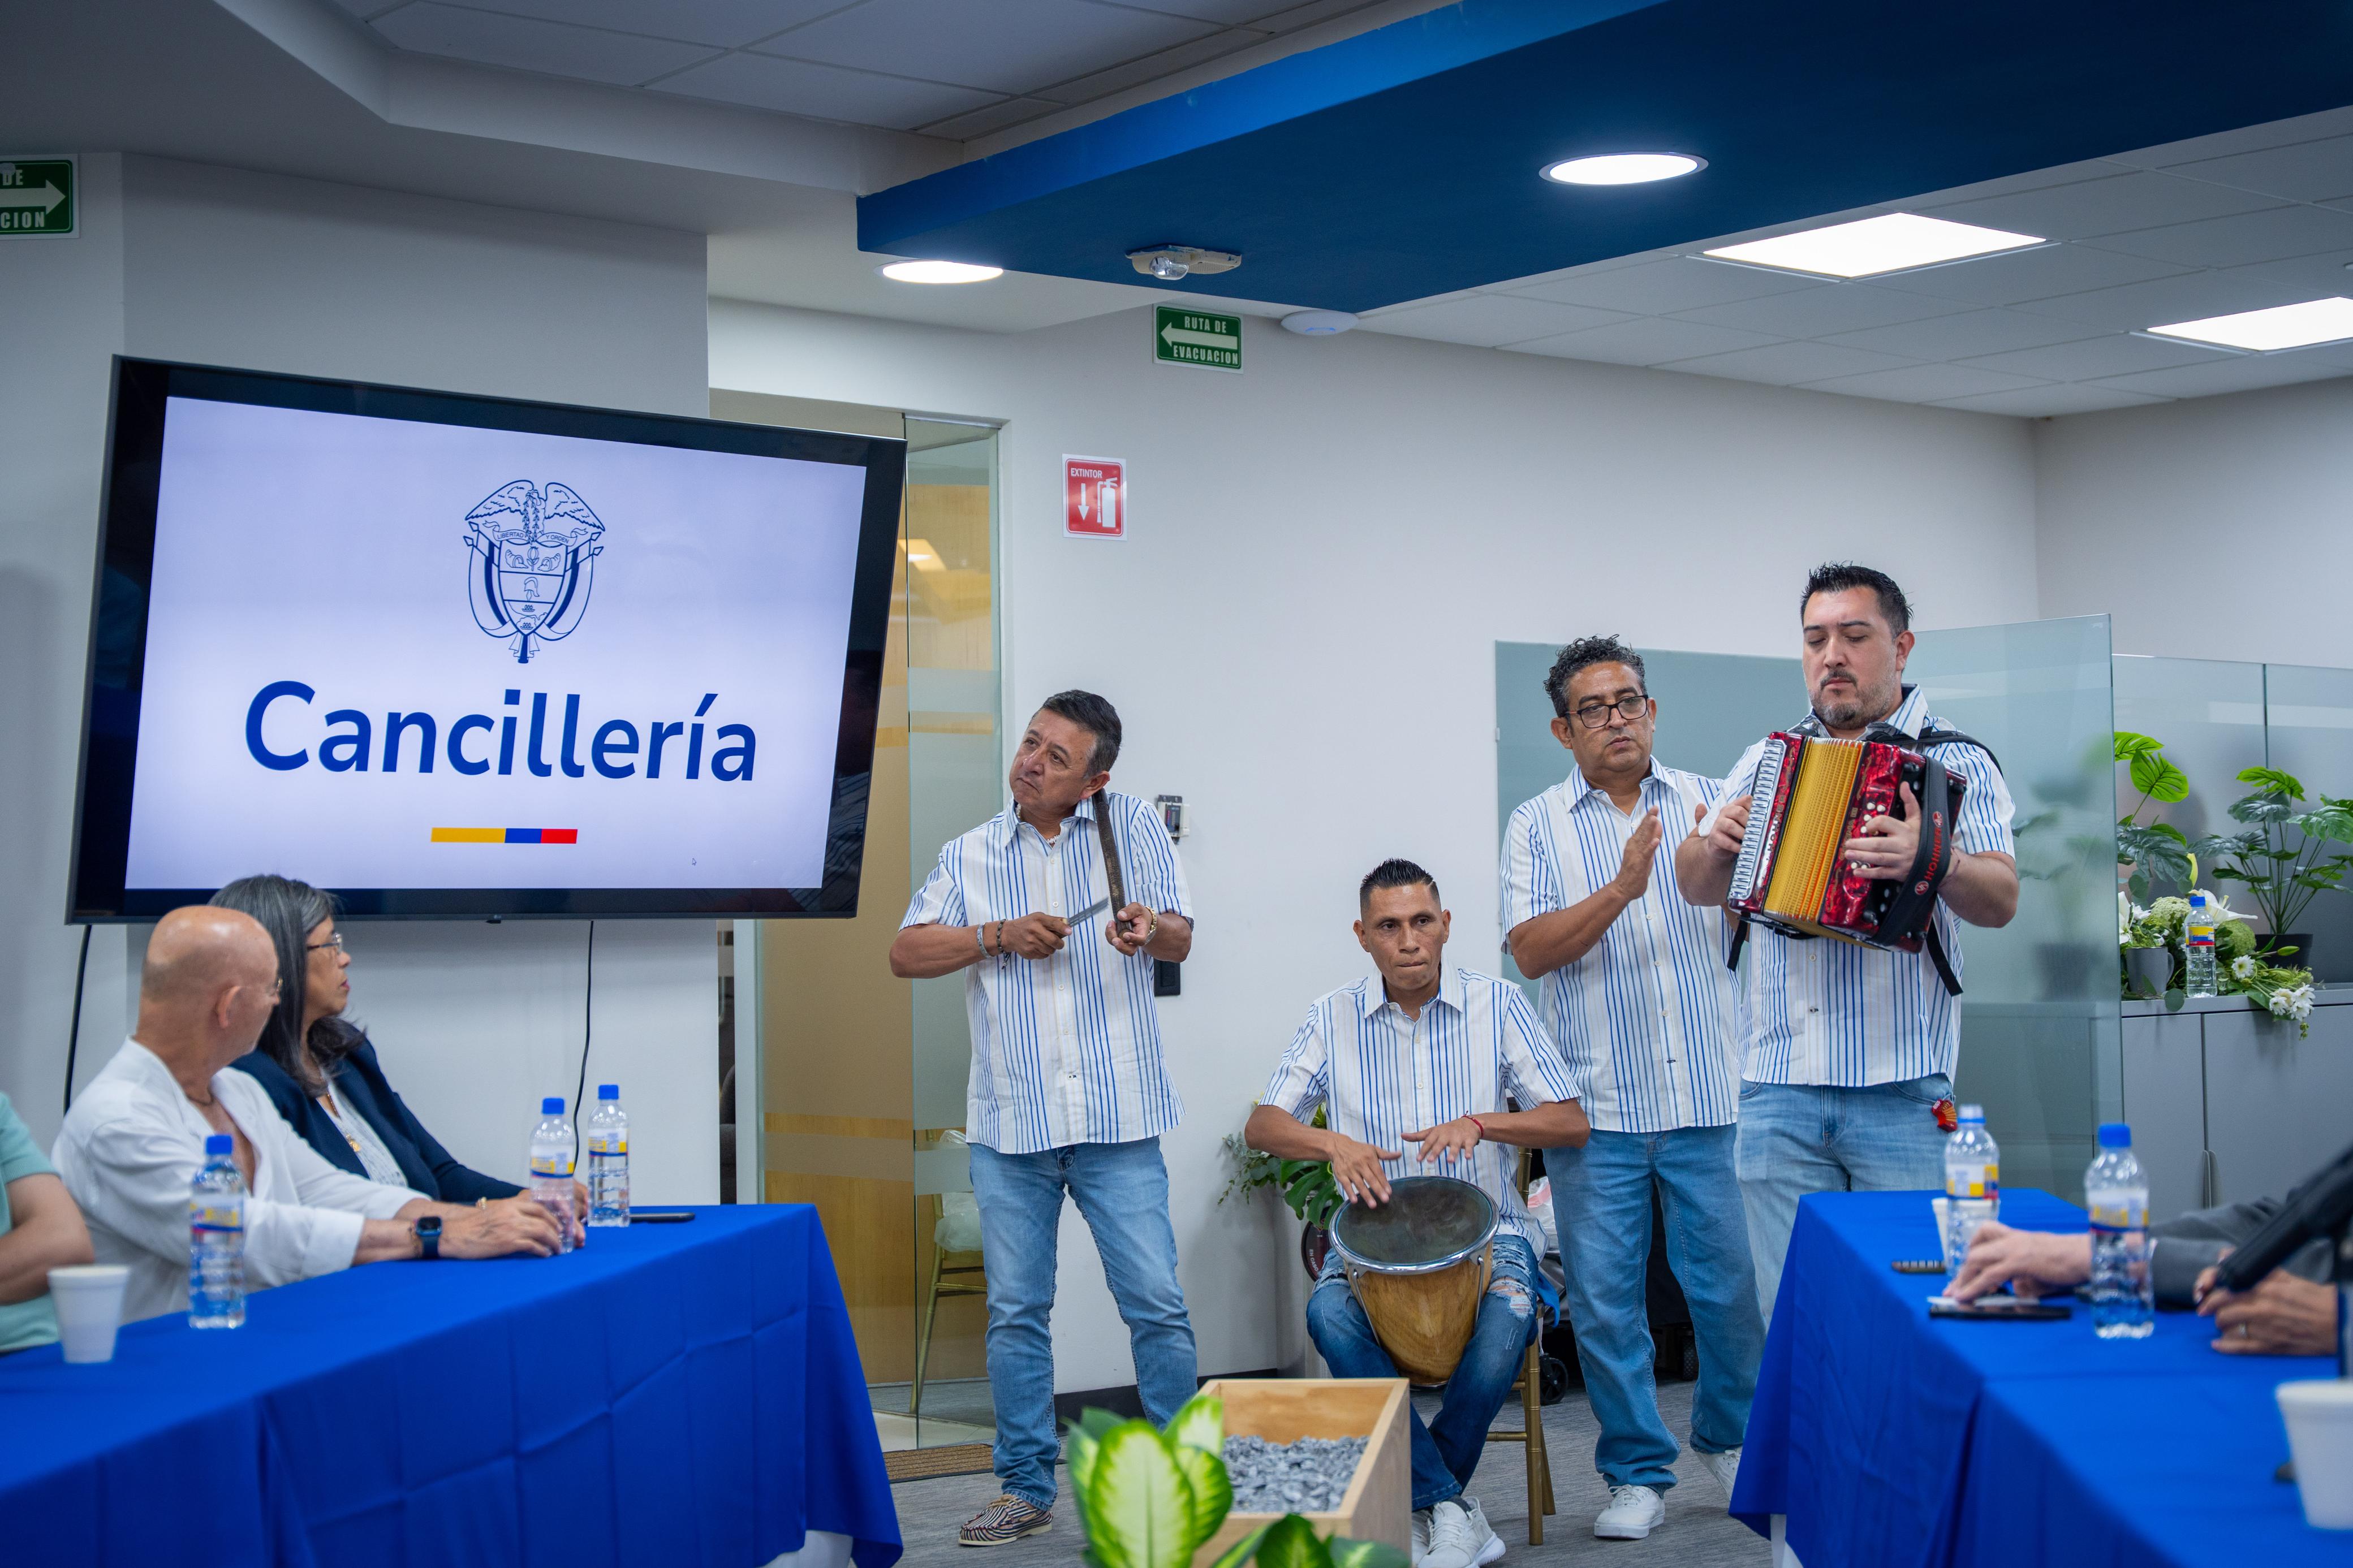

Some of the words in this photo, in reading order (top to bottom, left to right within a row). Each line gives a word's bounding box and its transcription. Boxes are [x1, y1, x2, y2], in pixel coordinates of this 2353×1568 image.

[2, 169, 24, 186] DE
[1184, 316, 1210, 331] RUTA
[1214, 320, 1227, 333] DE
[1173, 345, 1238, 365] EVACUACION
[1070, 467, 1102, 478] EXTINTOR
[550, 534, 569, 543] ORDEN
[245, 680, 756, 781] Cancillería
[1768, 795, 1787, 852] HOHNER
[1924, 827, 1942, 881] HOHNER
[1310, 1258, 1319, 1272] CASO
